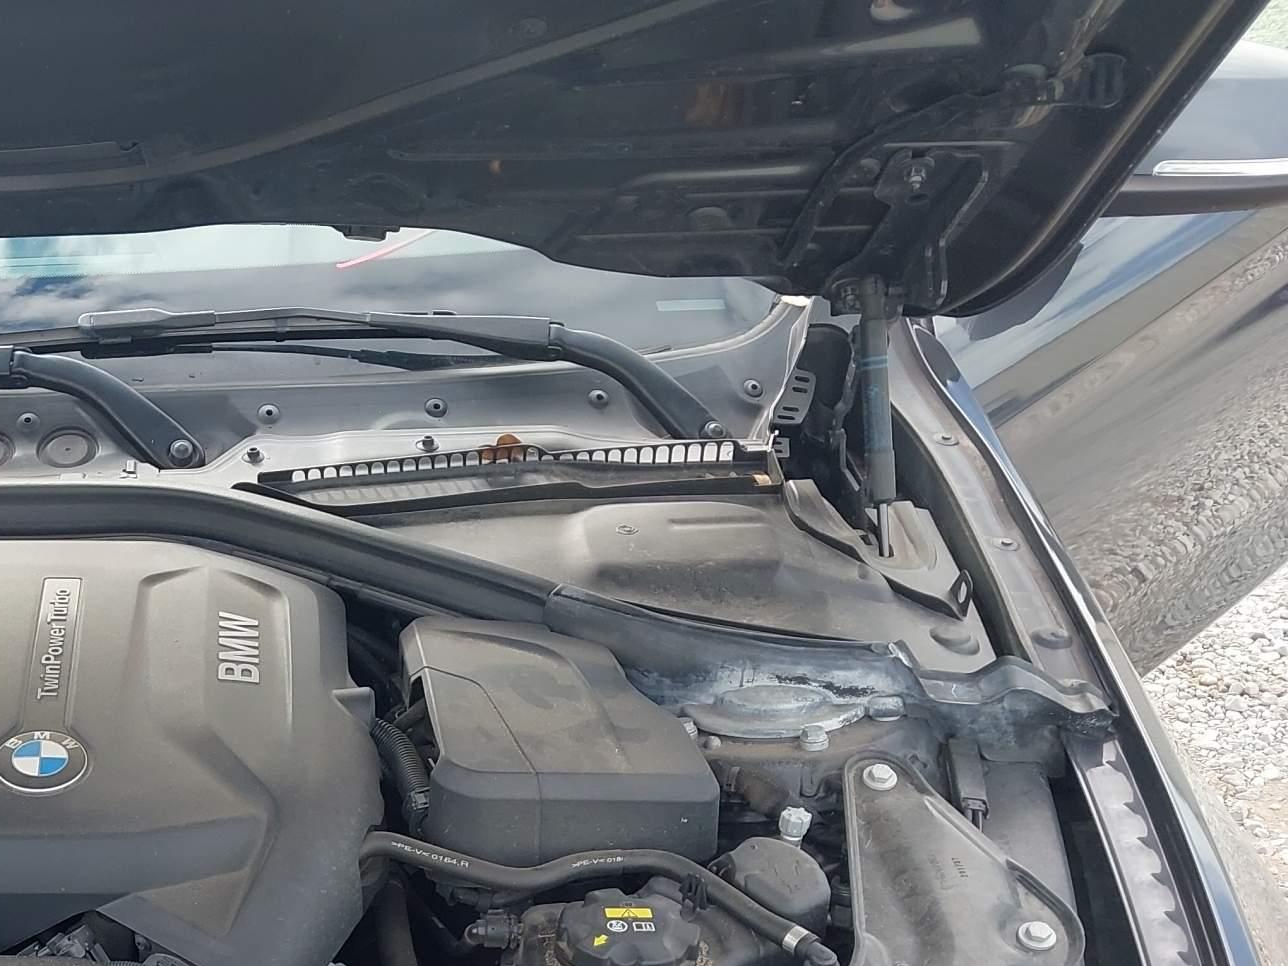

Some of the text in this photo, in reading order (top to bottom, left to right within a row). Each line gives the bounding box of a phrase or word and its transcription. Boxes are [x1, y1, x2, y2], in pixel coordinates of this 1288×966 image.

[37, 588, 71, 700] TwinPower Turbo
[216, 611, 261, 684] BMW
[5, 731, 81, 750] BMW
